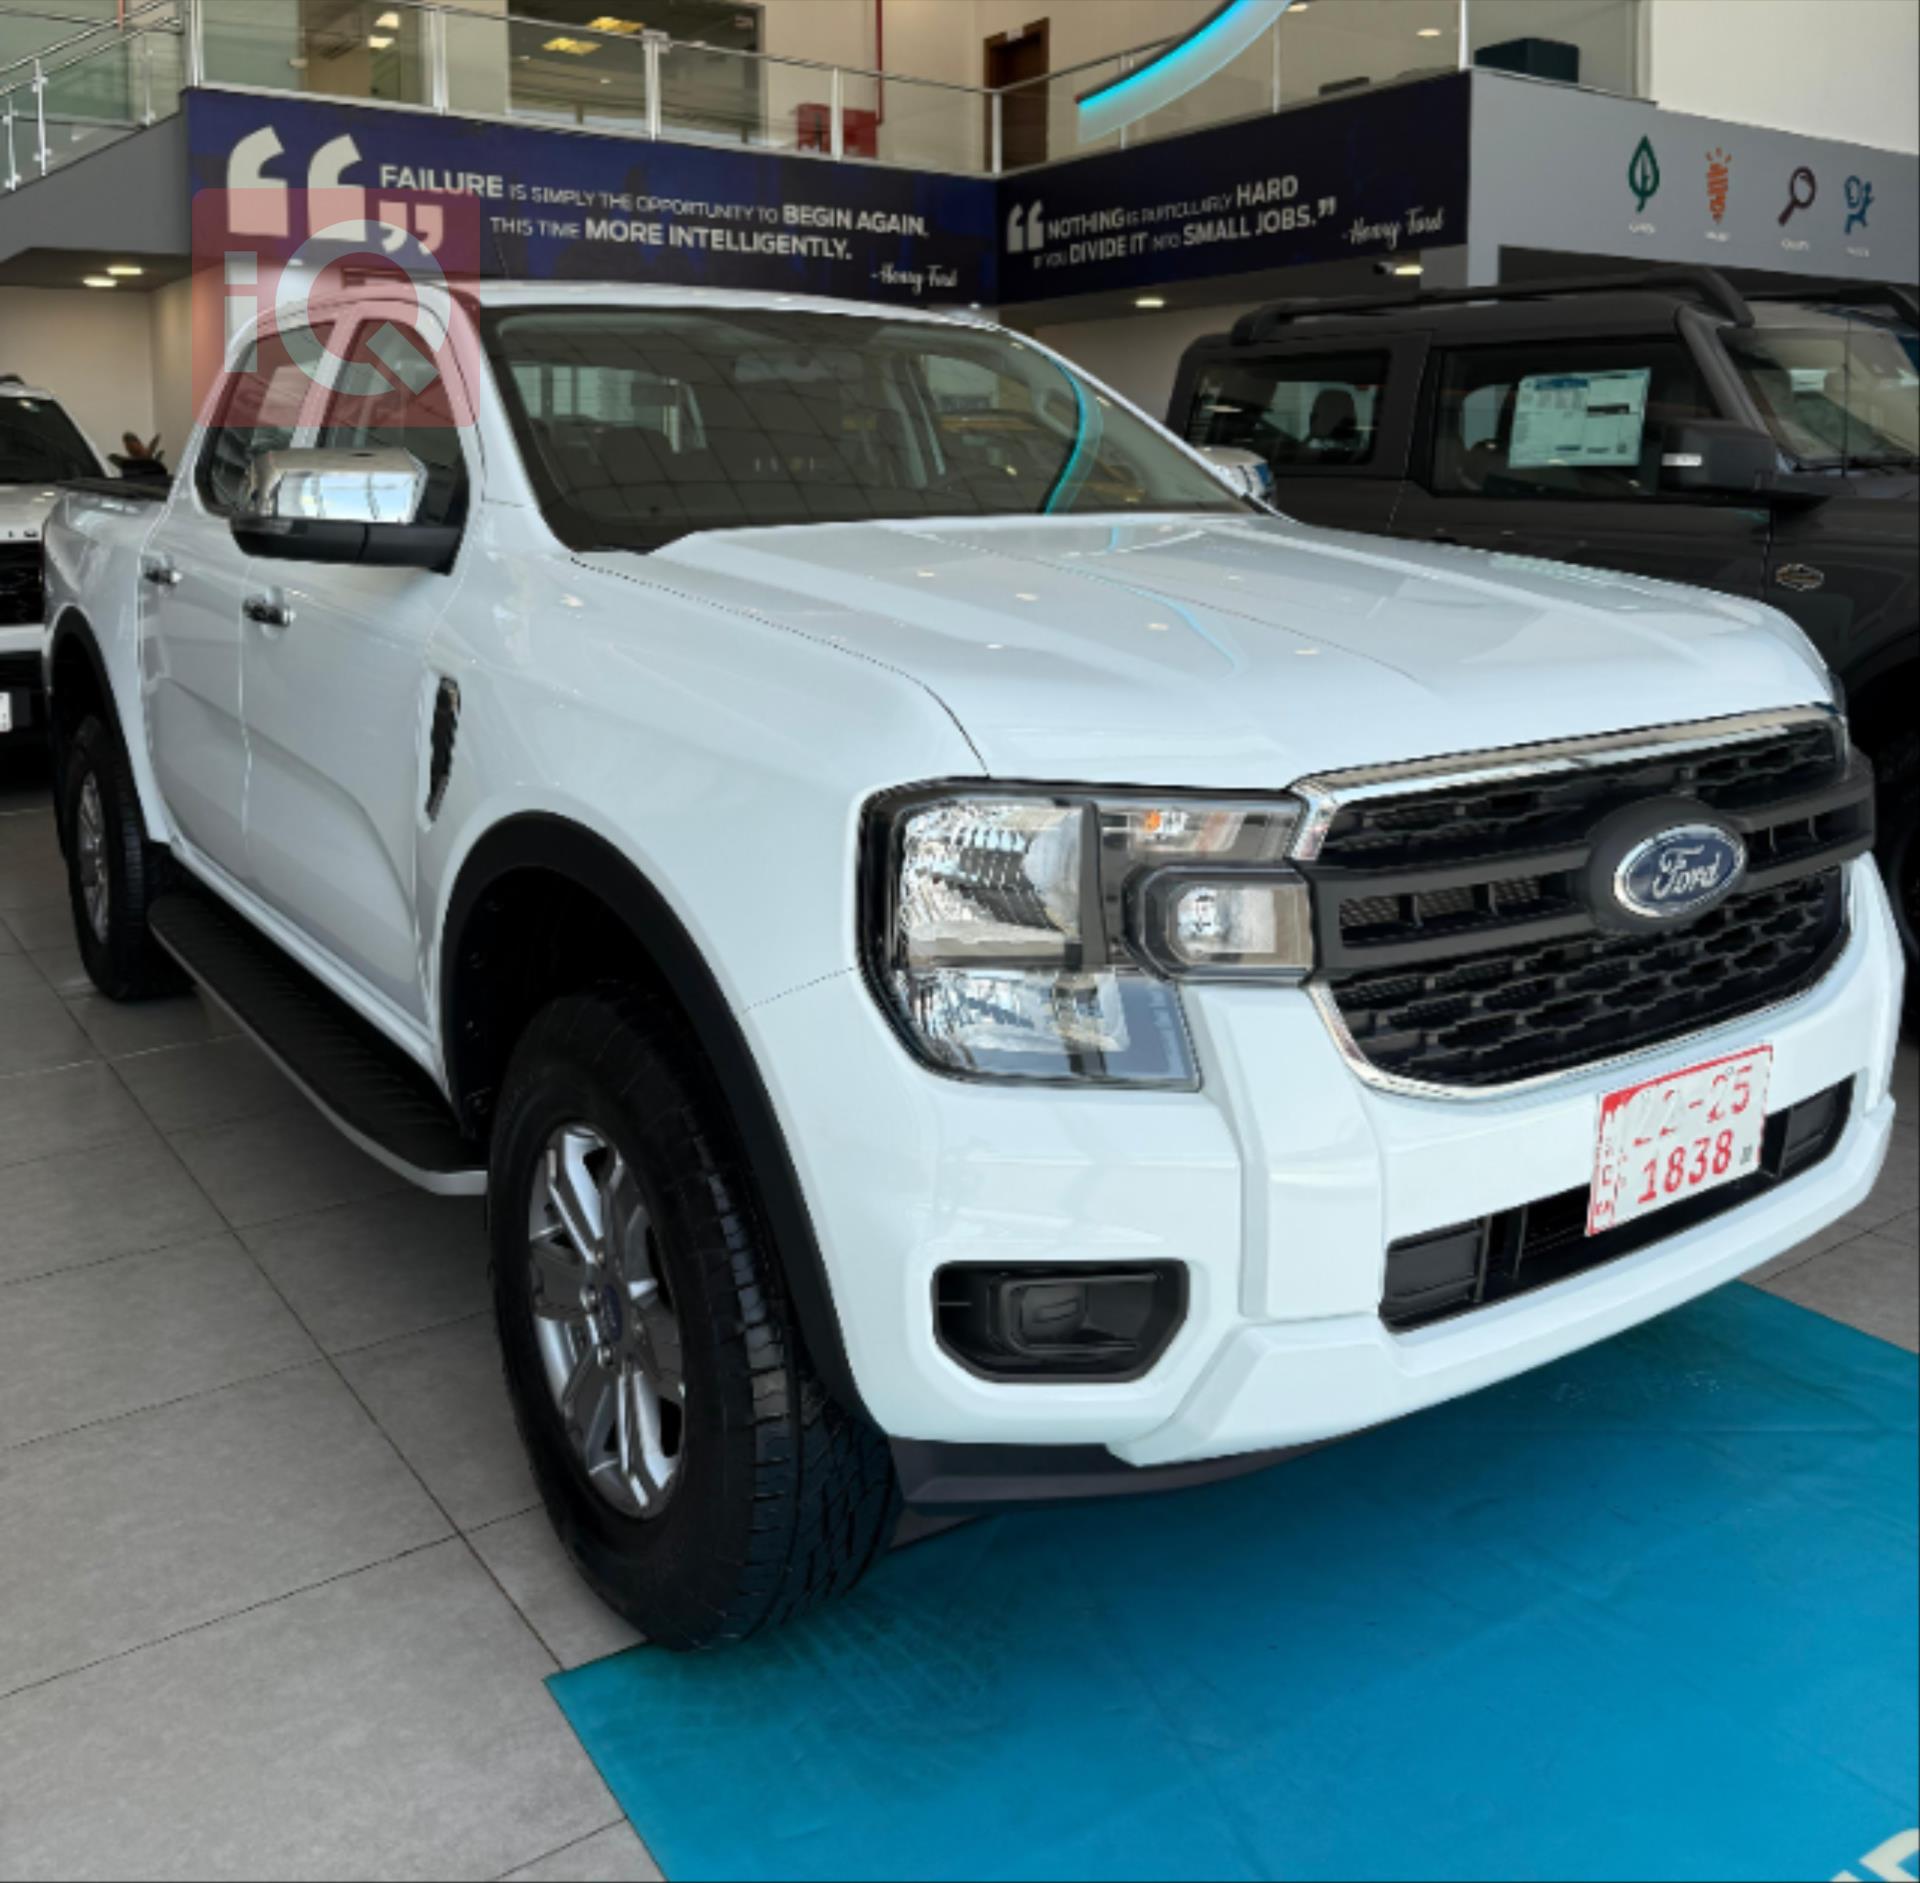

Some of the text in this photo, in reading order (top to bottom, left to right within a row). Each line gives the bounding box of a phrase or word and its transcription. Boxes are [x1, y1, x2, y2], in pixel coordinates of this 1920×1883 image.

[380, 164, 504, 198] FAILURE
[531, 186, 594, 208] SIMPLY
[599, 190, 634, 212] THE
[758, 206, 778, 223] TO
[782, 204, 852, 230] BEGIN
[1047, 207, 1126, 240] NOTHING
[1236, 174, 1299, 208] HARD
[490, 216, 853, 260] THIS TIME MORE INTELLIGENTLY.
[1069, 234, 1128, 265] DIVIDE
[1129, 231, 1149, 255] IT
[1183, 216, 1251, 246] SMALL
[1652, 843, 1722, 899] Ford
[1637, 1128, 1734, 1204] 1838
